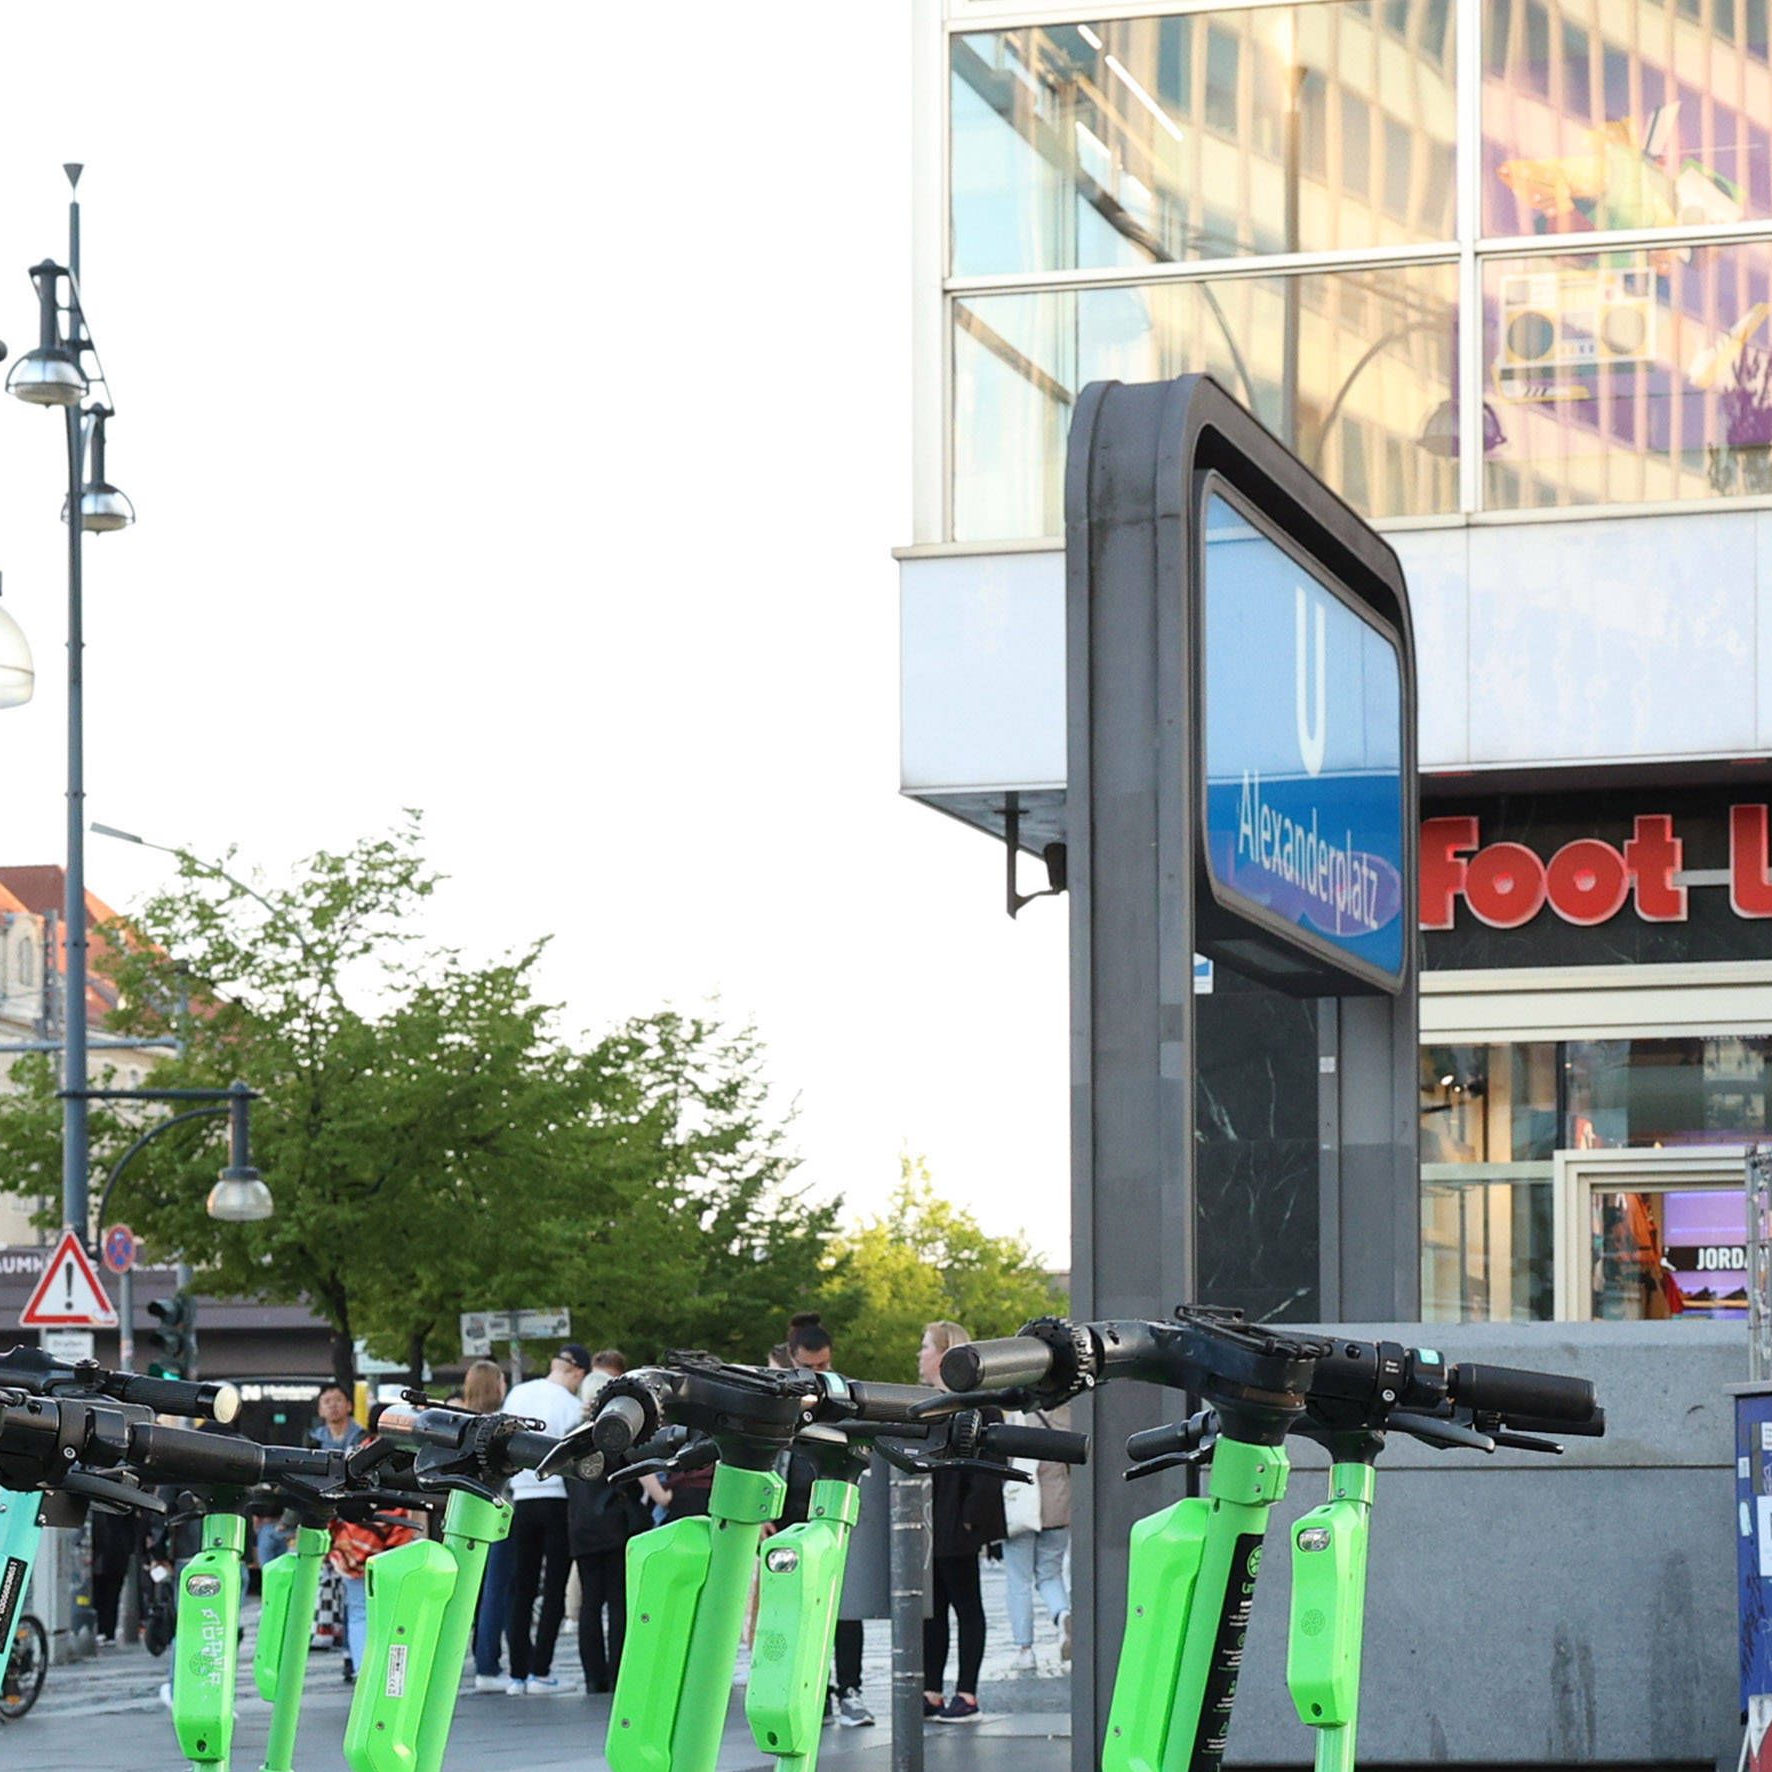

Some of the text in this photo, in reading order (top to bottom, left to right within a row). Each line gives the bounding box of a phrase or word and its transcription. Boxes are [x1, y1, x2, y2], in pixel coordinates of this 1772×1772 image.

[1295, 587, 1326, 777] U
[1238, 768, 1379, 934] Alexanderplatz
[1419, 813, 1688, 930] Foot
